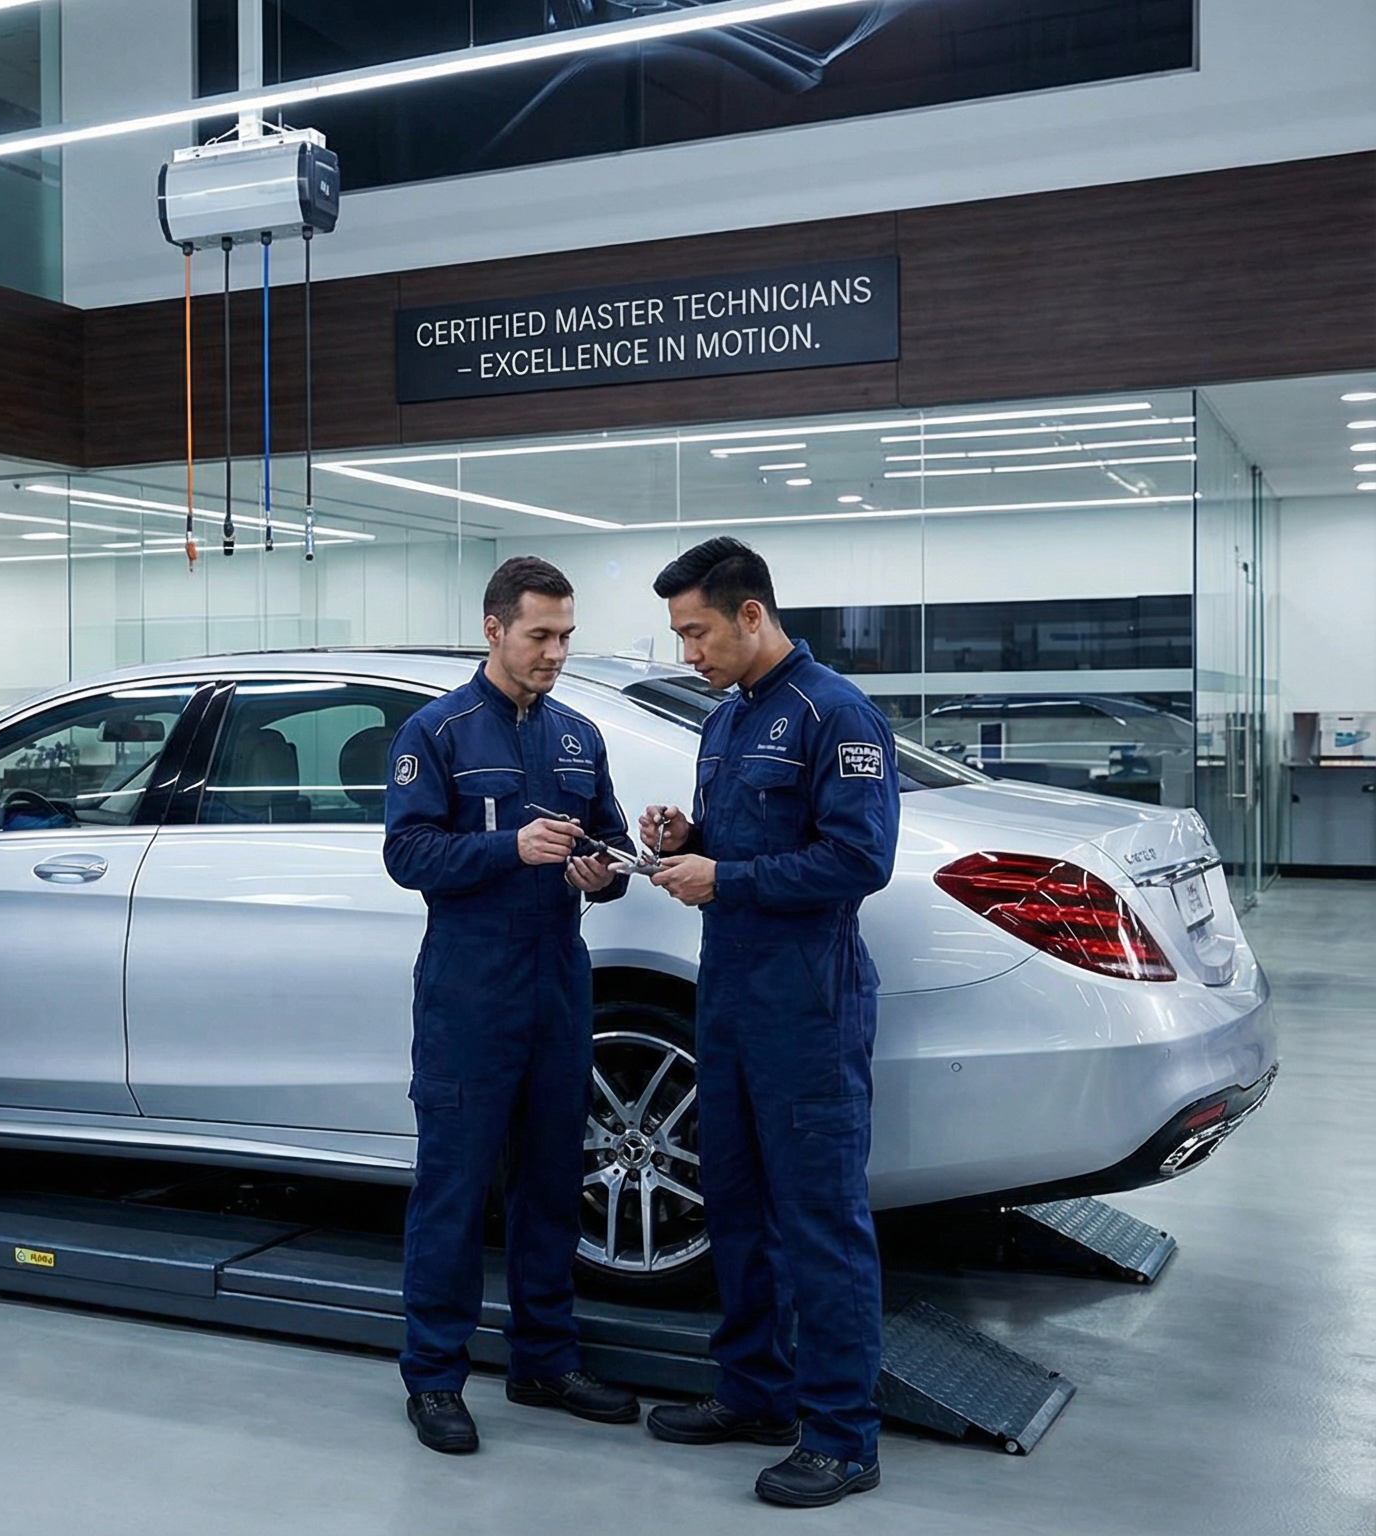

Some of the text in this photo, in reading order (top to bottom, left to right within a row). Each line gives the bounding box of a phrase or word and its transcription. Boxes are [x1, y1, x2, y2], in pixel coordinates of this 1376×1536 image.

[416, 276, 872, 347] CERTIFIED MASTER TECHNICIANS
[480, 345, 649, 379] EXCELLENCE
[659, 335, 685, 363] IN
[696, 322, 821, 359] MOTION.
